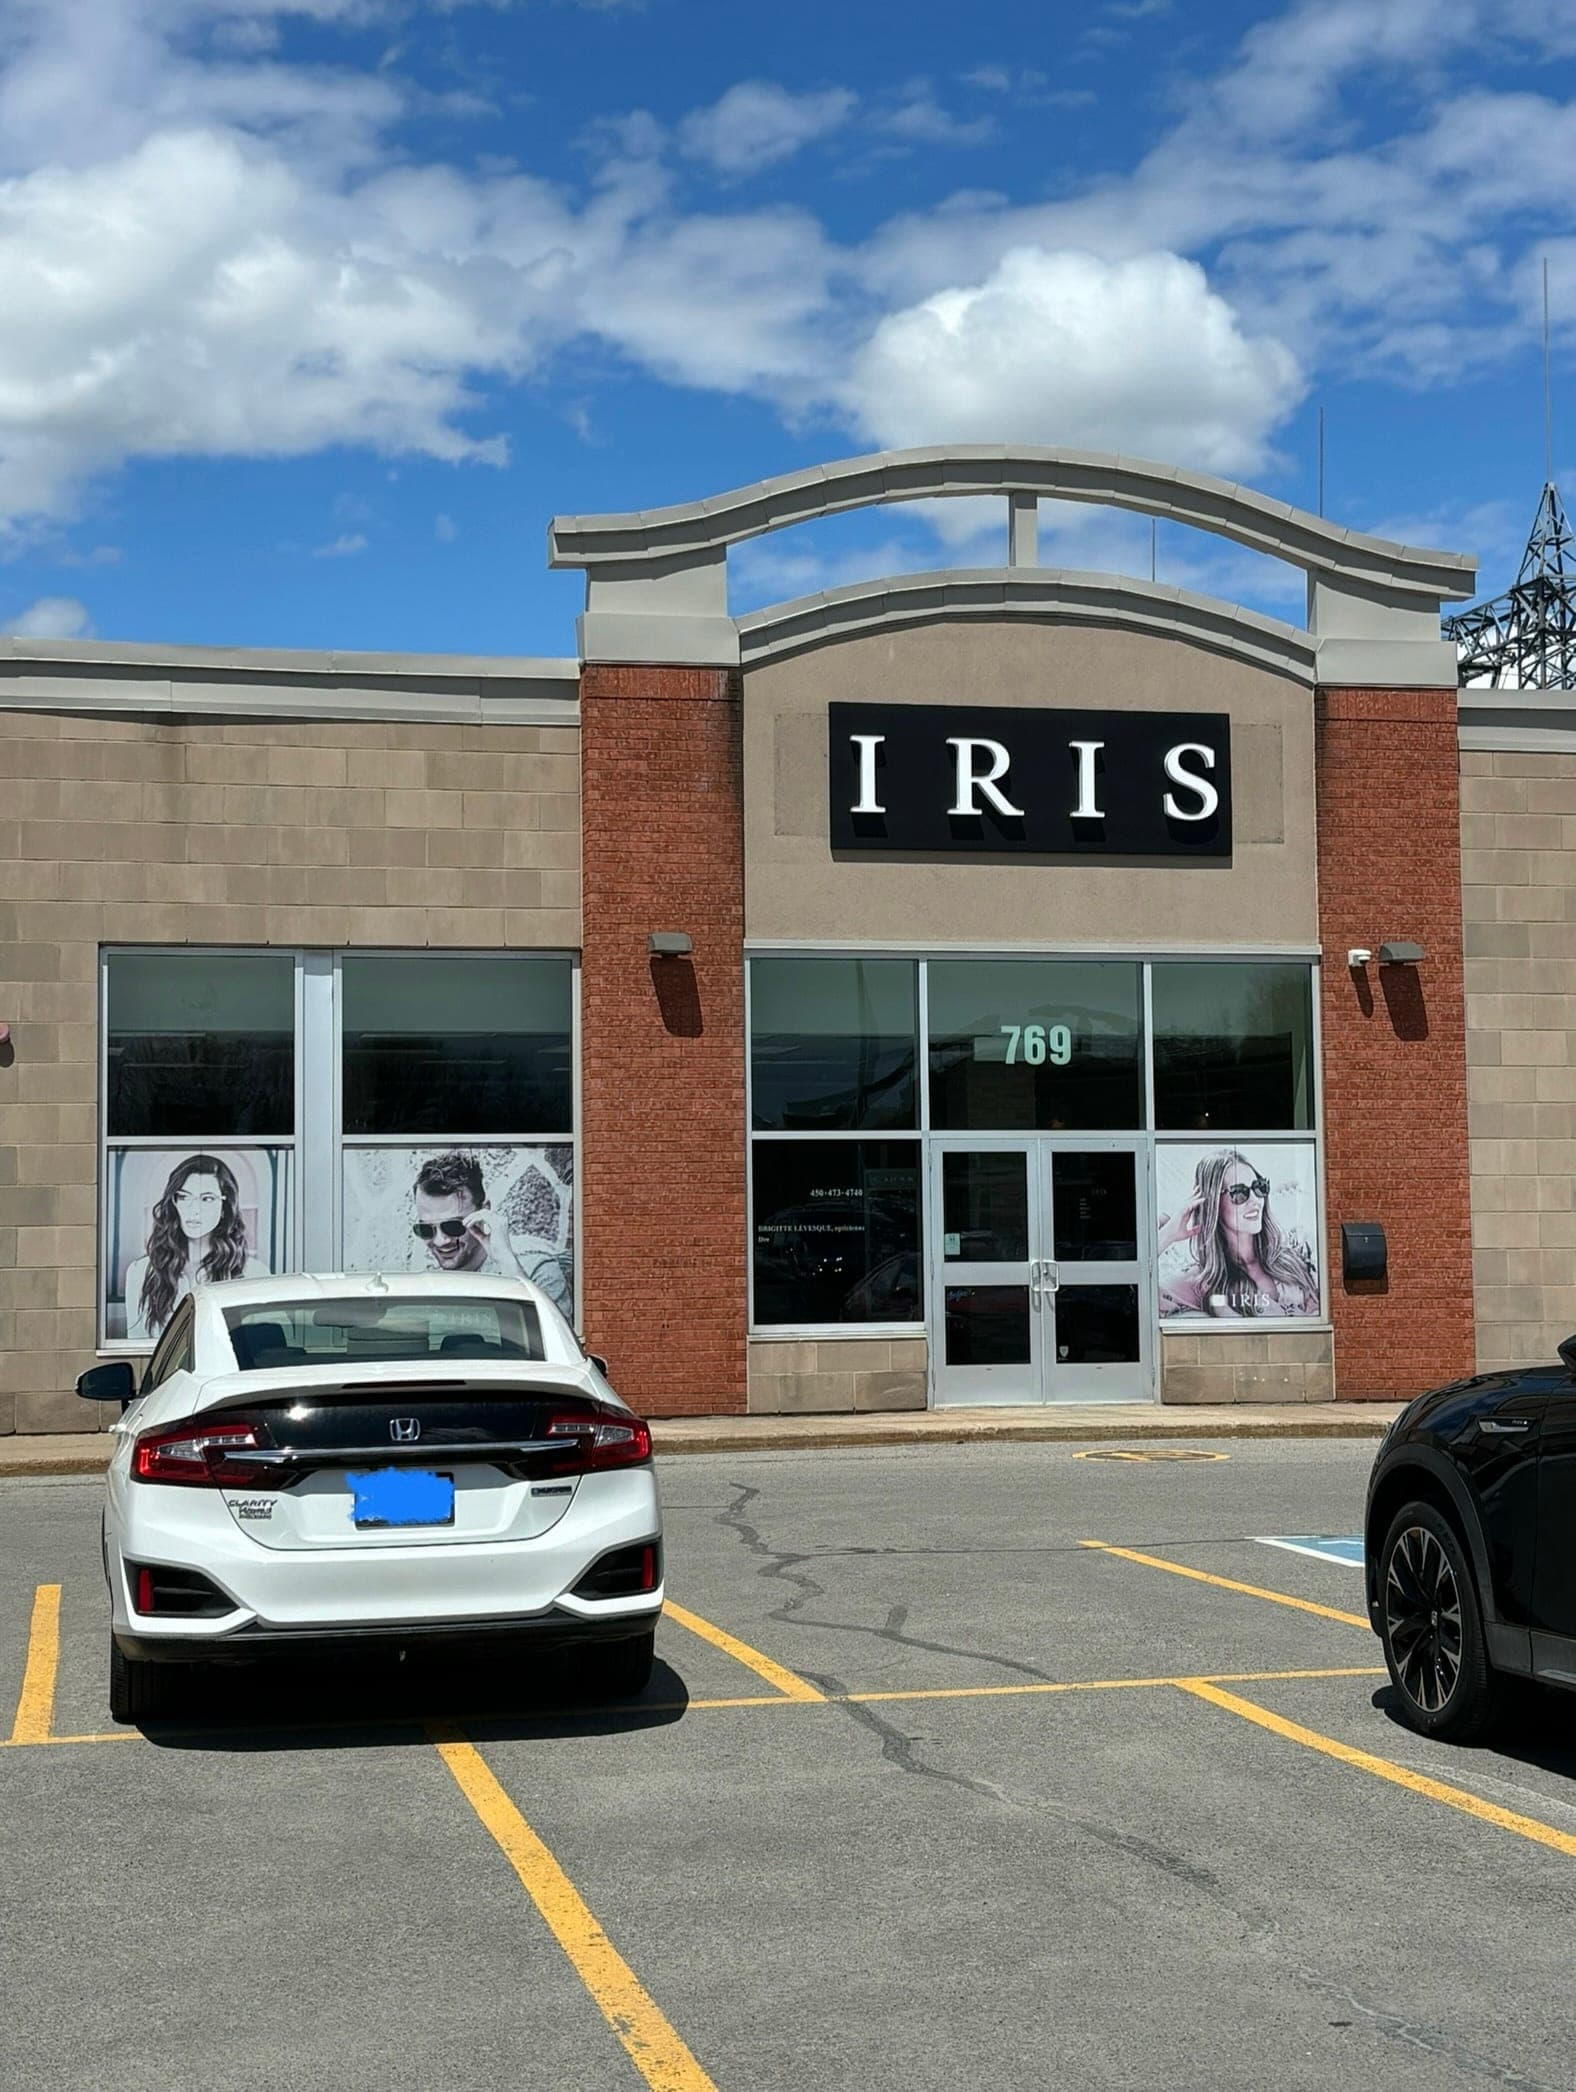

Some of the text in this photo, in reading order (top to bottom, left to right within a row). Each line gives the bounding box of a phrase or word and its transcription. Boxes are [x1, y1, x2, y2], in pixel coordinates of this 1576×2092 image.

[849, 734, 1219, 821] IRIS
[1000, 1024, 1072, 1065] 769
[1231, 1293, 1270, 1307] IRIS
